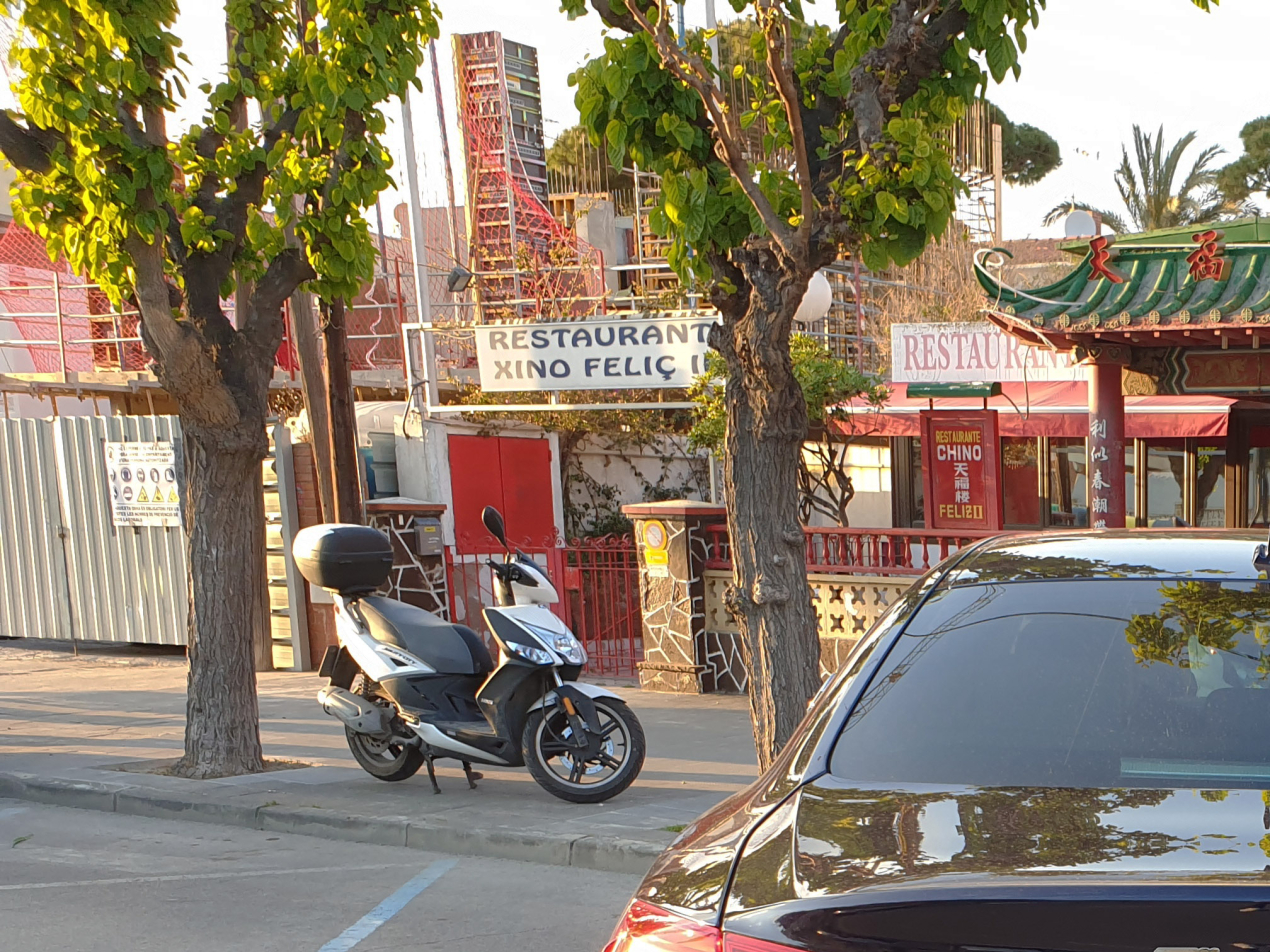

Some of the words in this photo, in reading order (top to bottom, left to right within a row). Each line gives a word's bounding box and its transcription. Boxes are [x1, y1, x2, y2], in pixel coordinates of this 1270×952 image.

[488, 323, 712, 350] RESTAURANT
[903, 332, 1090, 371] RESTAURAN
[494, 359, 571, 380] XINO
[584, 355, 676, 381] FELIÇ
[935, 430, 981, 444] RESTAURANTE
[936, 444, 983, 461] CHINO
[953, 462, 971, 504] 天福楼
